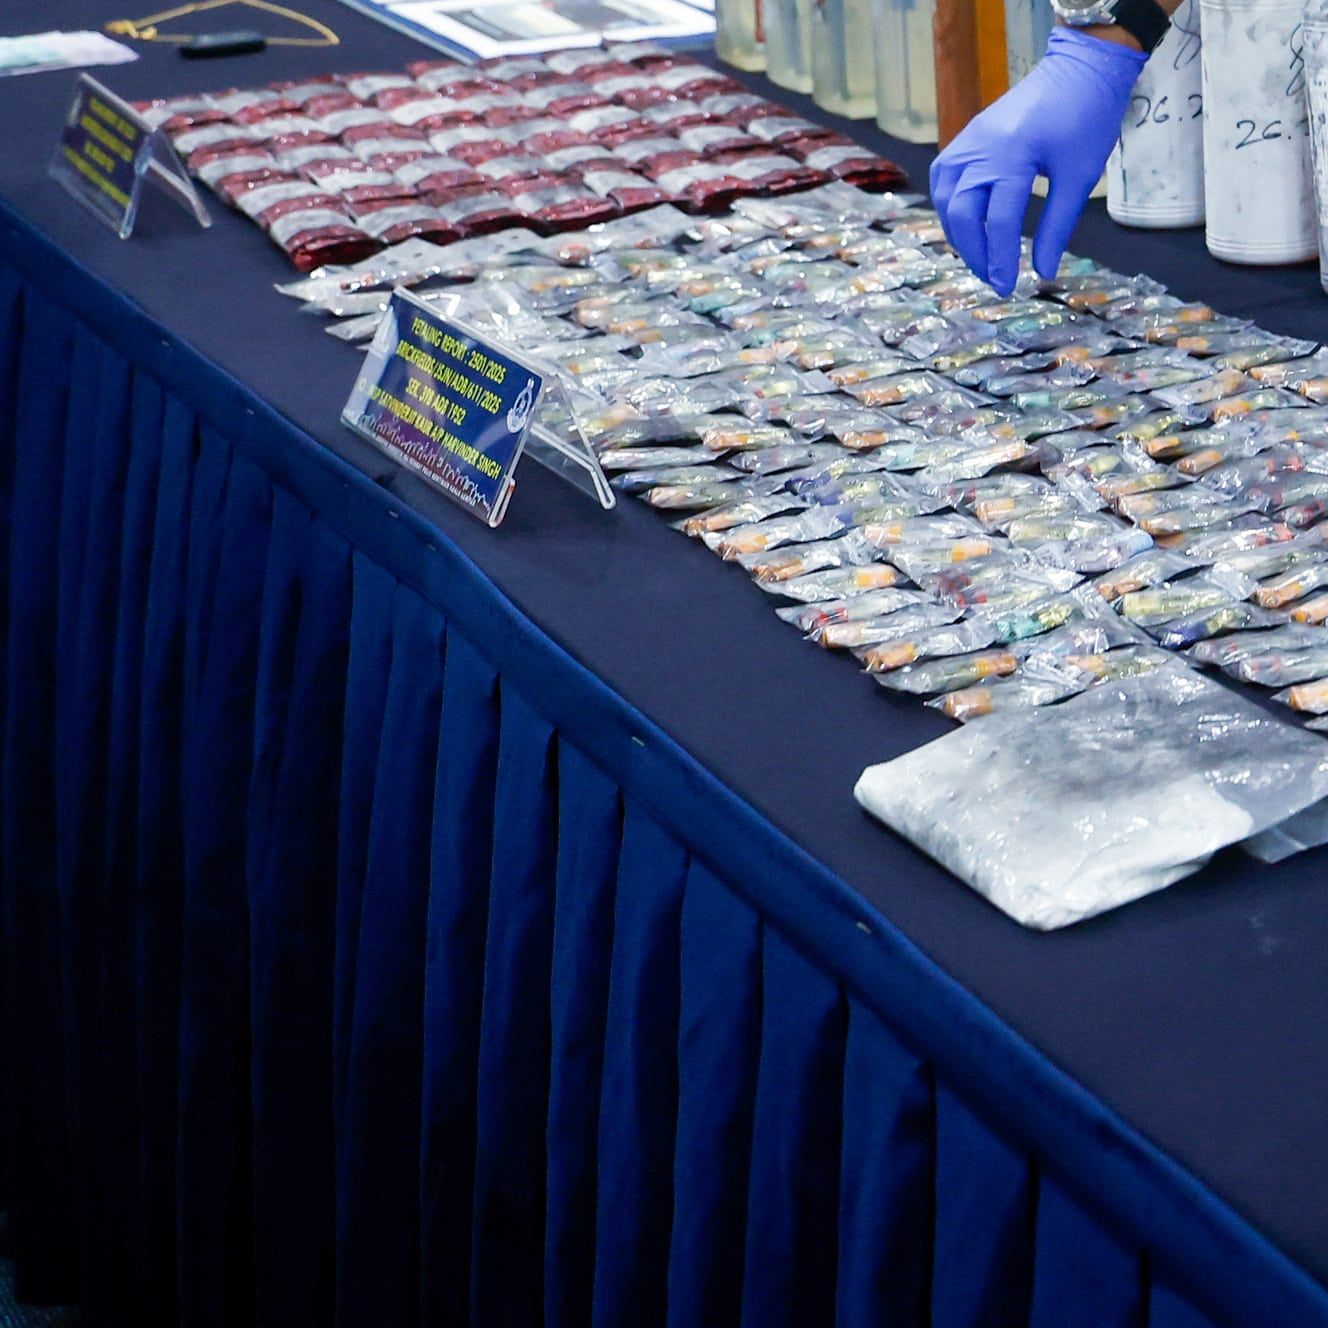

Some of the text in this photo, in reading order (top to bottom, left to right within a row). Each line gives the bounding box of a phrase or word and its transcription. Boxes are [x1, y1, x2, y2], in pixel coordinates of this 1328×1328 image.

[412, 317, 443, 347] PETALING
[441, 334, 468, 361] REPORT
[468, 350, 507, 384] 2501/2025
[431, 393, 450, 415] ADB
[447, 403, 467, 426] 1952
[476, 454, 502, 481] SINGH
